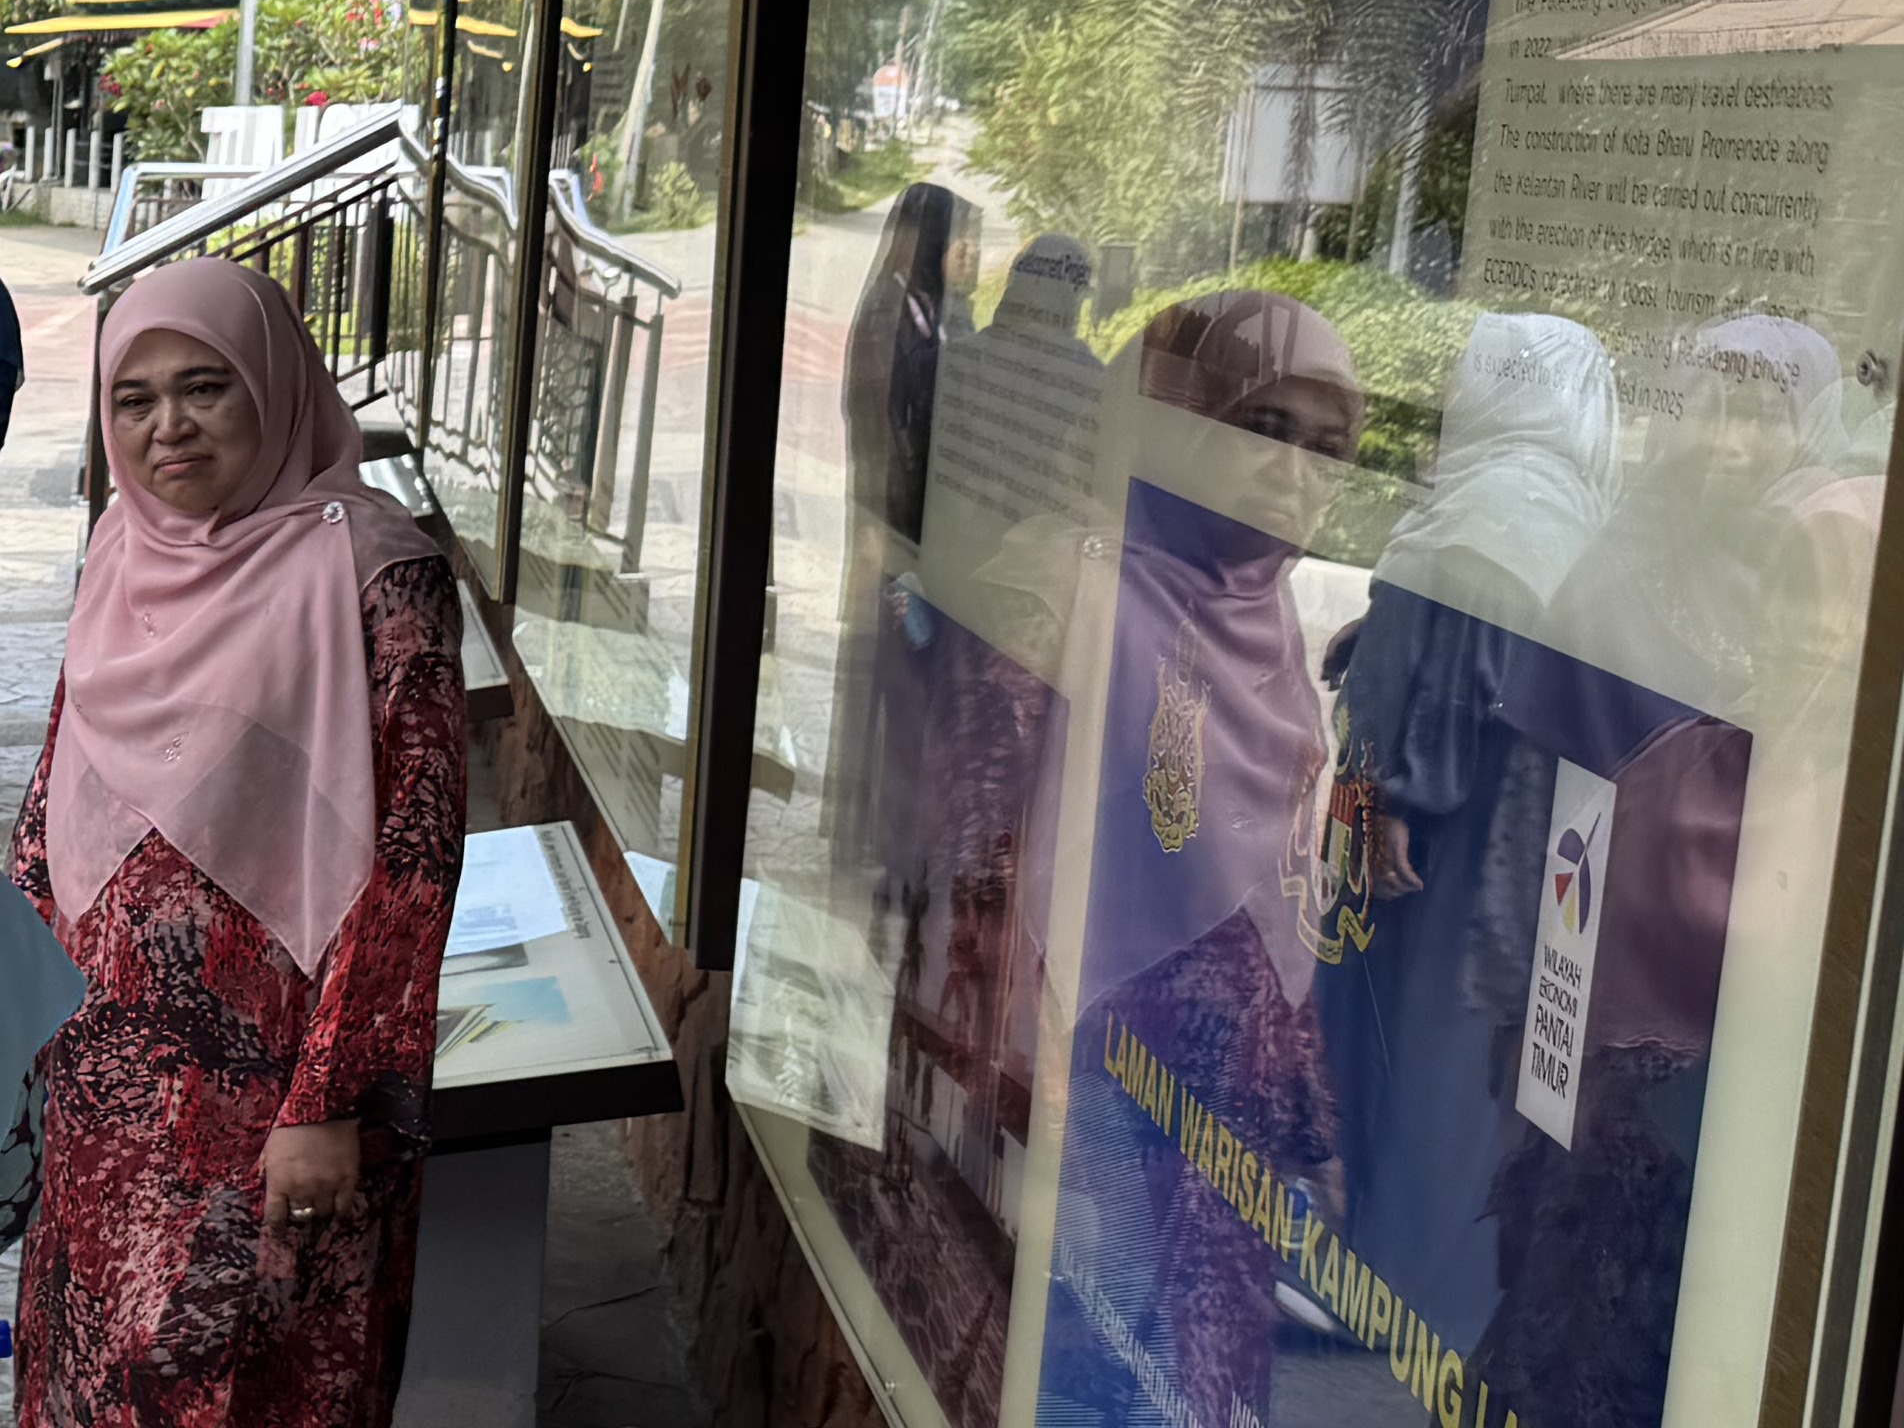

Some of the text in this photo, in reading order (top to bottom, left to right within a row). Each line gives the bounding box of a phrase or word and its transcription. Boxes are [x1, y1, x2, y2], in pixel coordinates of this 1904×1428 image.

[1599, 78, 1632, 106] there
[1634, 84, 1657, 106] are
[1660, 83, 1694, 113] many
[1701, 77, 1739, 109] travel
[1500, 123, 1830, 173] The construction of Kota Bharu Promenade along
[1493, 169, 1512, 196] the
[1515, 172, 1565, 200] Kelantan
[1570, 174, 1602, 202] River
[1605, 177, 1627, 204] will
[1631, 179, 1649, 207] be
[1703, 184, 1726, 213] out
[1730, 190, 1822, 228] concurrently
[1514, 216, 1534, 244] the
[1536, 219, 1585, 250] erection
[1678, 234, 1716, 265] which
[1784, 246, 1815, 278] with
[1666, 286, 1715, 317] tourism
[1653, 389, 1685, 421] 2025
[1534, 1004, 1574, 1057] PANTAI
[1531, 1041, 1569, 1099] TIMUR
[1104, 1010, 1174, 1136] LAMAN
[1180, 1086, 1296, 1262] WARISAN
